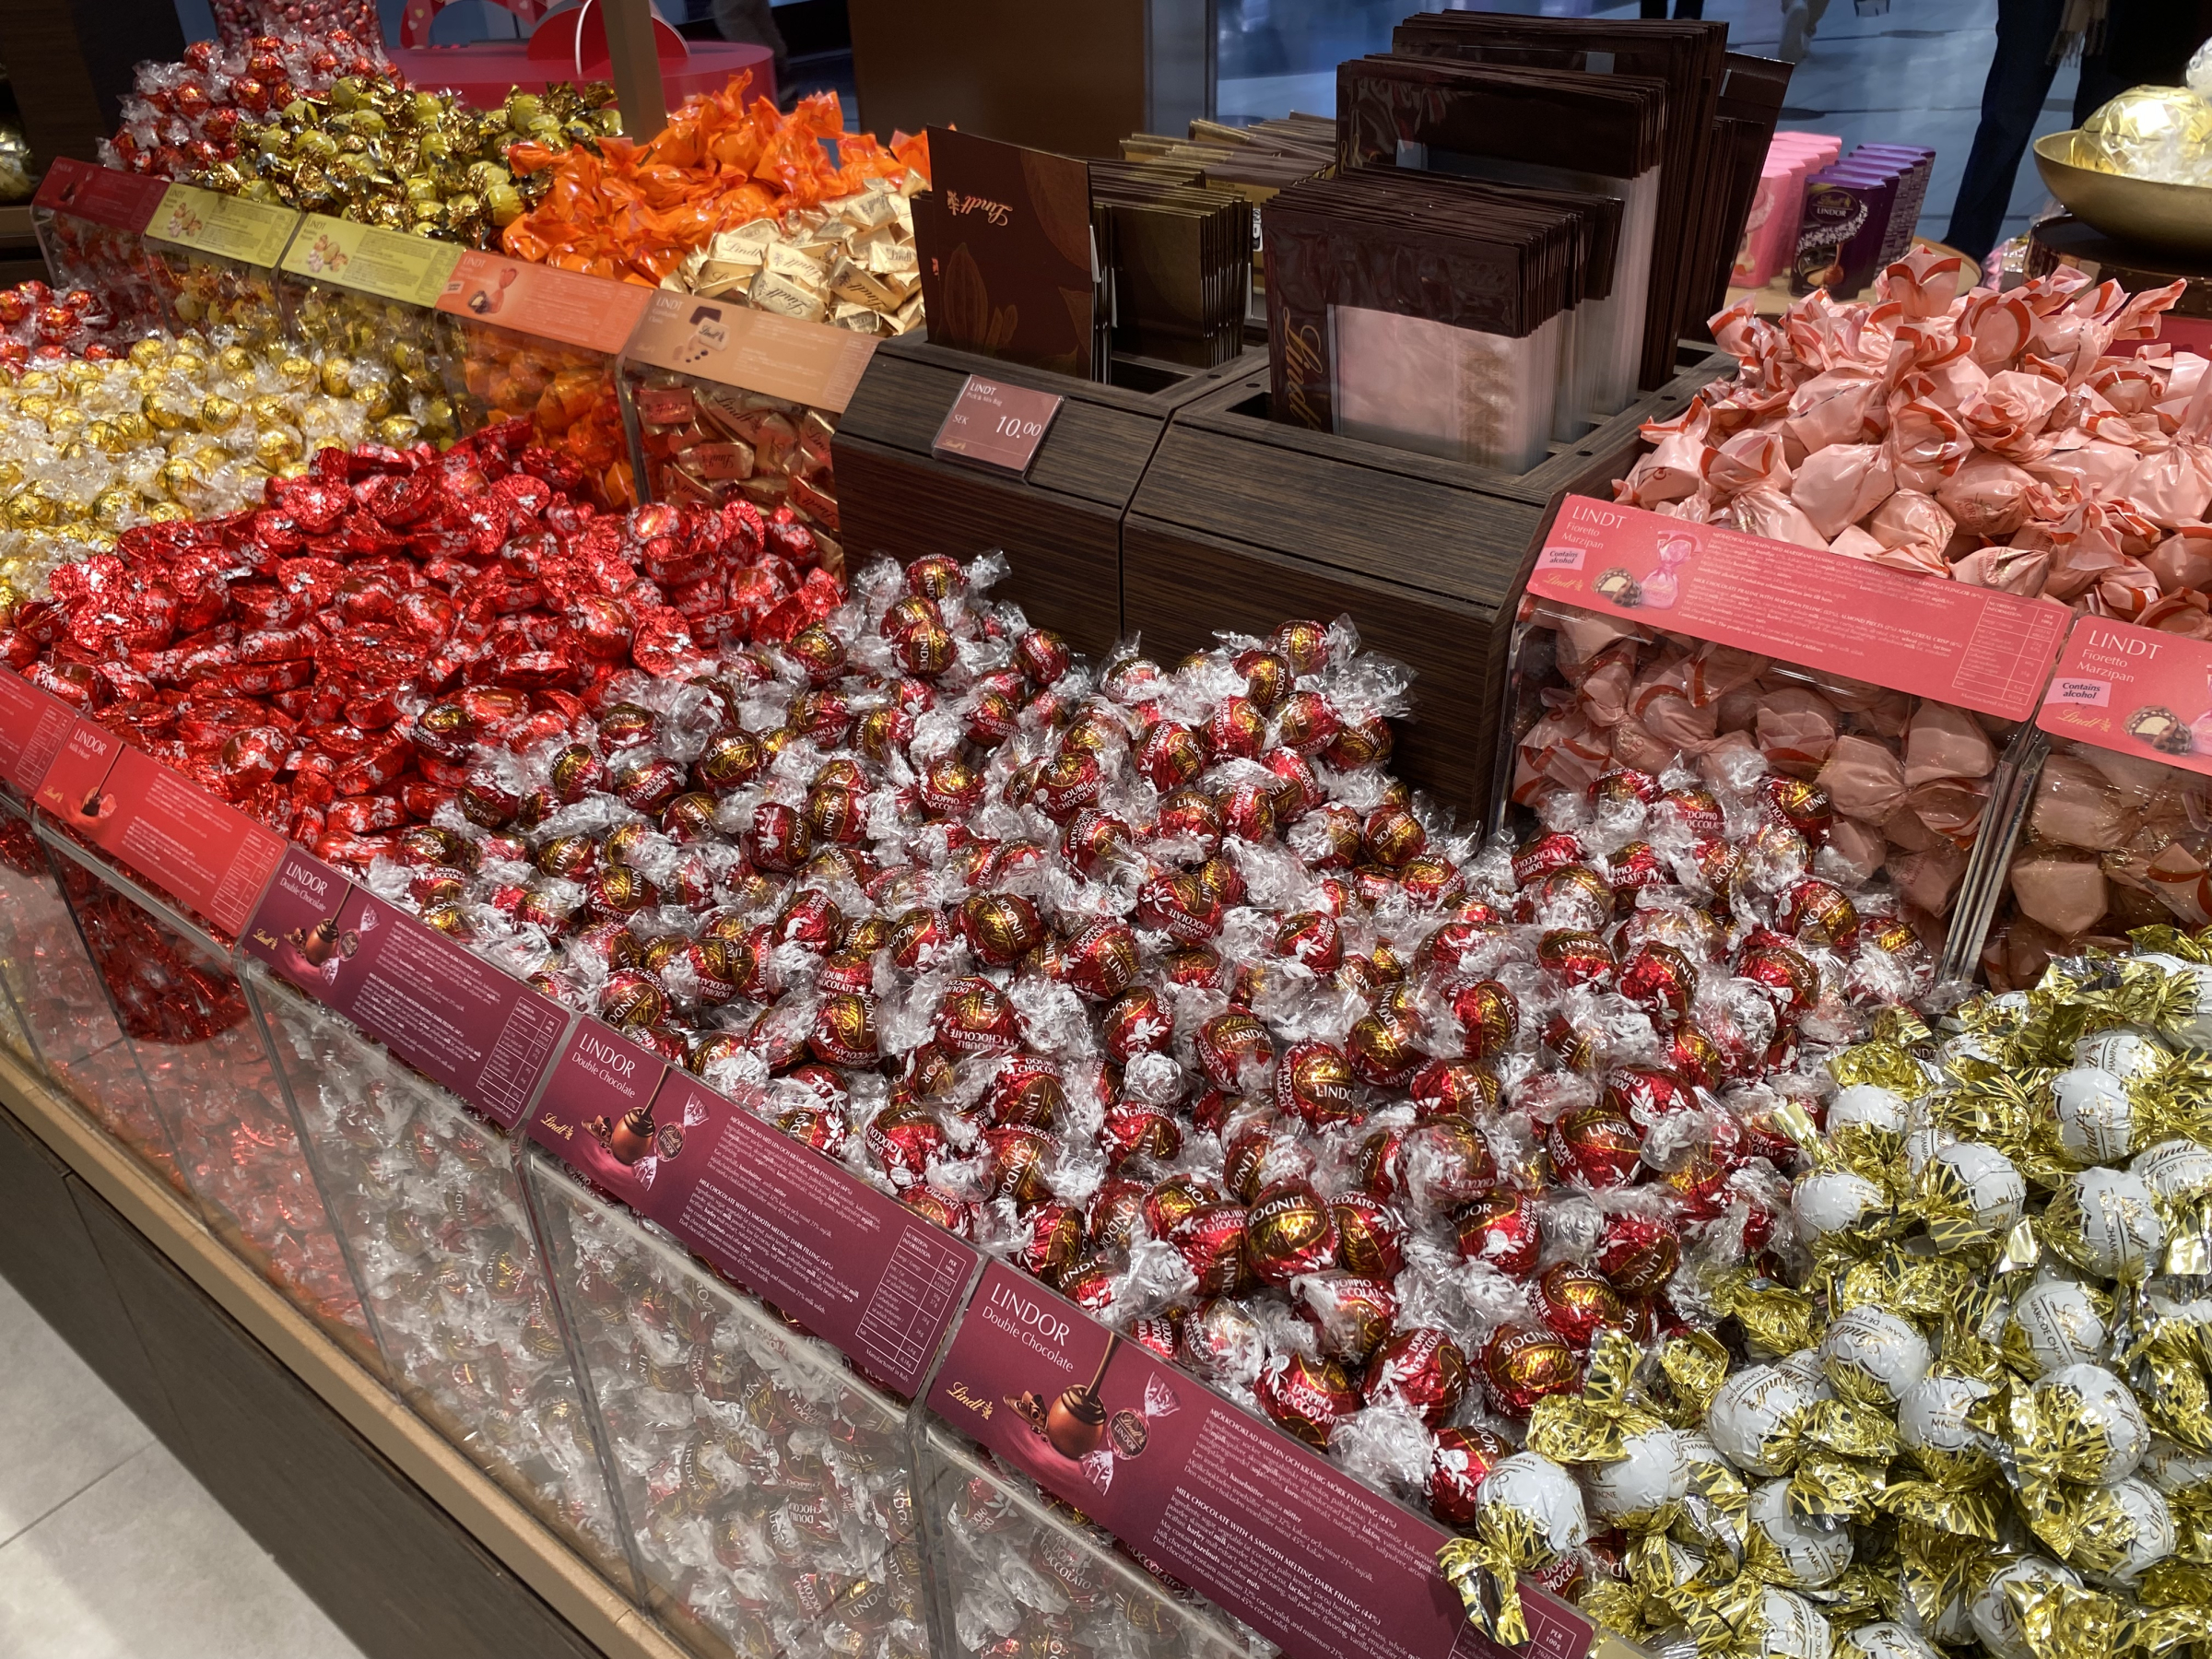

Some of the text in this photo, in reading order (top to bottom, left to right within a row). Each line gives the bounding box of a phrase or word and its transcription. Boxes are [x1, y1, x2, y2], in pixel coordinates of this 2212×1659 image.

[960, 195, 1013, 227] Lindt
[1817, 207, 1847, 218] LINDOR
[725, 240, 763, 258] Lindt
[656, 297, 685, 310] LINDT
[767, 285, 811, 316] Lindt
[847, 282, 889, 311] Lindt
[970, 382, 996, 395] LINDT
[952, 414, 1041, 438] SEK 10.00
[1566, 522, 1599, 536] Fioretto
[1572, 505, 1626, 528] LINDT
[1549, 546, 1578, 561] Contains
[1561, 532, 1603, 548] Marzipan
[1548, 554, 1574, 563] alcohol
[2081, 648, 2127, 667] Fioretto
[2088, 629, 2161, 659] LINDT
[2077, 661, 2134, 682] Marzipan
[2062, 682, 2100, 697] Contains
[2063, 684, 2097, 699] alcohol
[2055, 709, 2101, 727] Lindt
[74, 728, 106, 755] LINDOR
[705, 736, 744, 763] LINDOR
[931, 794, 960, 806] DOPPIO
[824, 794, 842, 837] LINDOR
[1688, 811, 1718, 820] DOPPIO
[555, 834, 583, 870] LINDOR
[1712, 844, 1740, 885] LINDOR
[286, 862, 327, 895] LINDOR
[279, 877, 325, 912] Double Chocolate
[1801, 888, 1841, 926] LINDOR
[997, 897, 1025, 940] LINDOR
[1077, 916, 1103, 947] DOPPIO
[949, 1028, 1003, 1043] CHOCOLATE
[579, 1033, 635, 1077] LINDOR
[571, 1052, 635, 1098] Double Chocolate
[540, 1112, 568, 1134] Lindt
[656, 1135, 676, 1154] LINDOR
[2144, 1142, 2196, 1169] Lindt
[999, 1140, 1021, 1200] LINDOR
[924, 1186, 958, 1208] DOPPIO
[1248, 1194, 1305, 1228] LINDOR
[901, 1237, 930, 1258] INFORMATION
[905, 1231, 927, 1248] NUTRITION
[948, 1258, 957, 1266] PER
[991, 1283, 1069, 1345] LINDOR
[982, 1305, 1073, 1371] Double Chocolate
[865, 1348, 895, 1371] Manufactured
[946, 1382, 984, 1410] Lindt
[1292, 1382, 1335, 1412] DOPPIO
[1110, 1424, 1136, 1451] LINDOR
[1116, 1412, 1145, 1440] Lindt
[1209, 1408, 1396, 1528] MJÖLKCHOKLAD MED LEN OCH KRÄMIG MÖRK FYLLNING (44%)
[1159, 1518, 1171, 1531] May
[1171, 1528, 1192, 1544] contain
[1192, 1539, 1219, 1562] hazelnuts
[1219, 1560, 1232, 1571] and
[1230, 1568, 1246, 1580] other
[1174, 1486, 1189, 1500] MILK
[1191, 1496, 1230, 1524] CHOCOLATE
[1230, 1521, 1248, 1537] WITH
[1253, 1537, 1284, 1560] SMOOTH
[1283, 1558, 1313, 1581] MELTING
[1313, 1577, 1334, 1594] DARK
[1334, 1590, 1360, 1611] FILLING
[1360, 1609, 1381, 1625] (44%)
[1310, 1538, 1322, 1548] och
[1152, 1535, 1165, 1547] Dark
[1166, 1546, 1192, 1564] chocolate
[1192, 1563, 1214, 1581] contains
[1241, 1595, 1253, 1608] 45%
[1253, 1606, 1271, 1620] cocoa
[1545, 1635, 1562, 1652] 100g
[1550, 1629, 1563, 1641] PER
